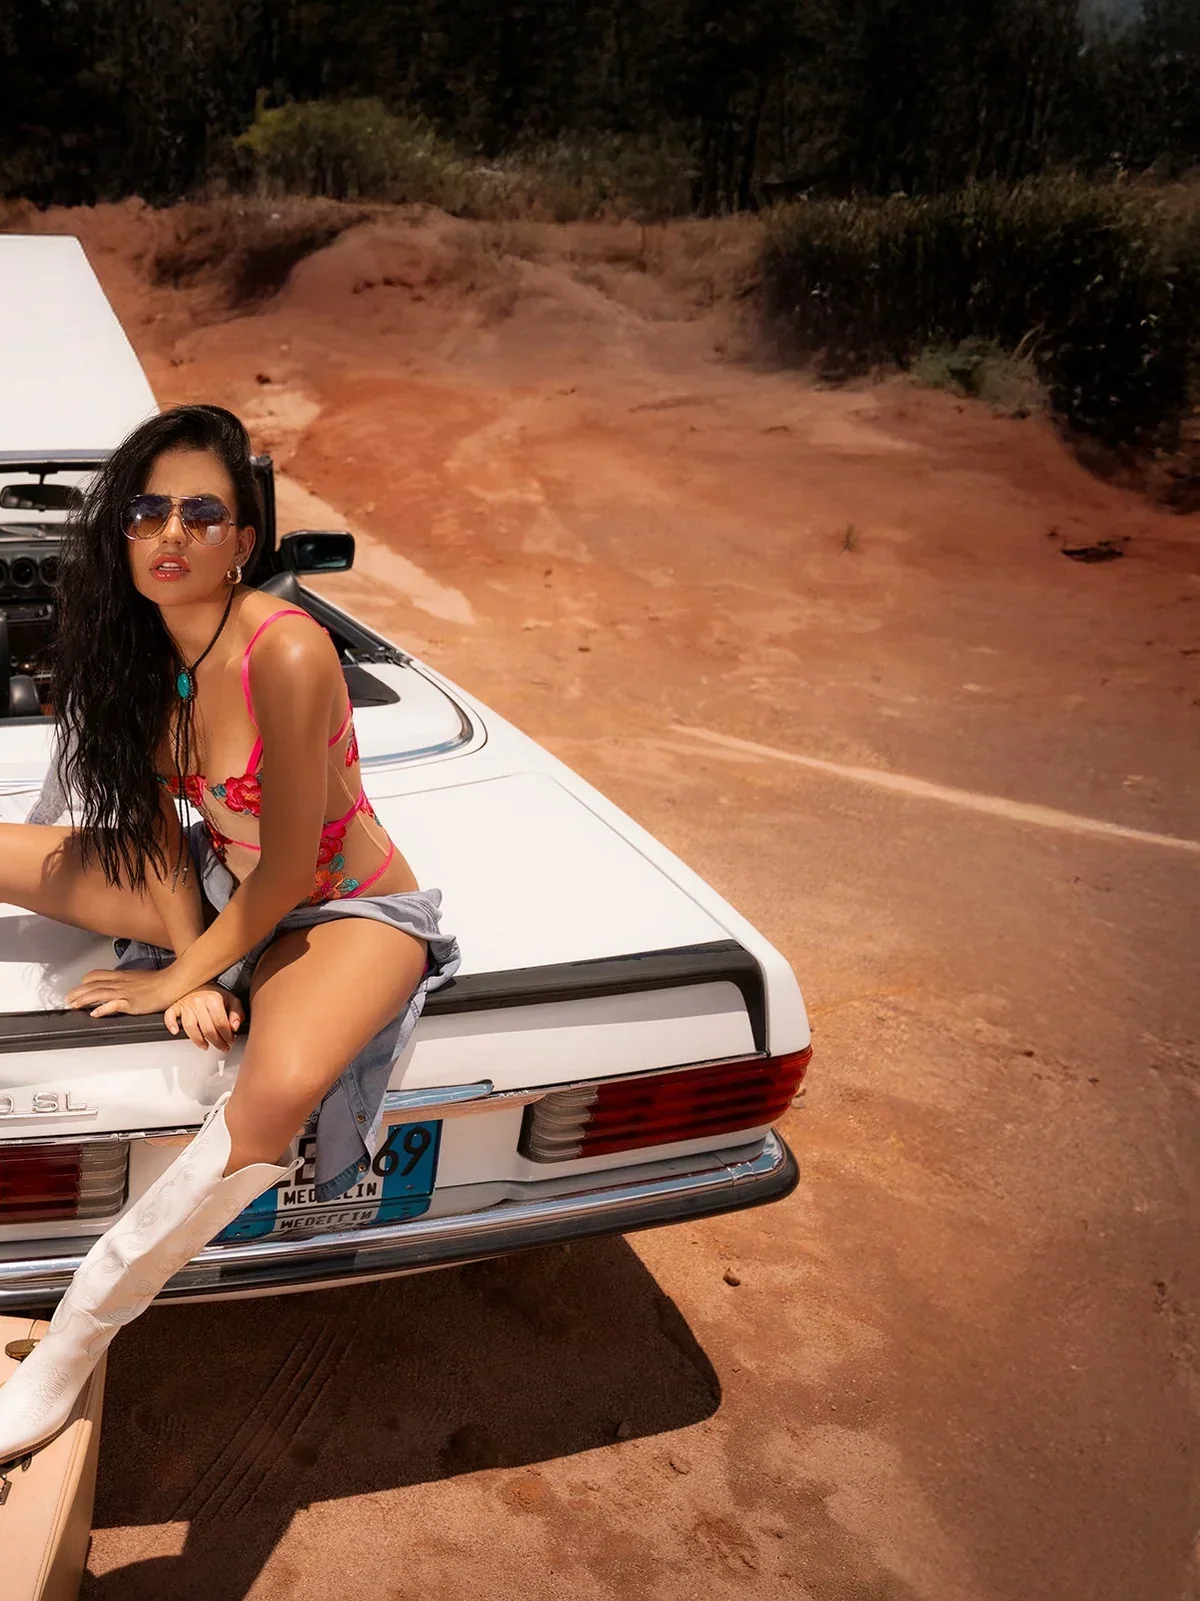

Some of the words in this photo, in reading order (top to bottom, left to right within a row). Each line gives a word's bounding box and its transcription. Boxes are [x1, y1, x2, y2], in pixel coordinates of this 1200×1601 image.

[32, 1091, 88, 1114] SL
[371, 1125, 432, 1178] 69
[283, 1182, 377, 1206] MEDLIN
